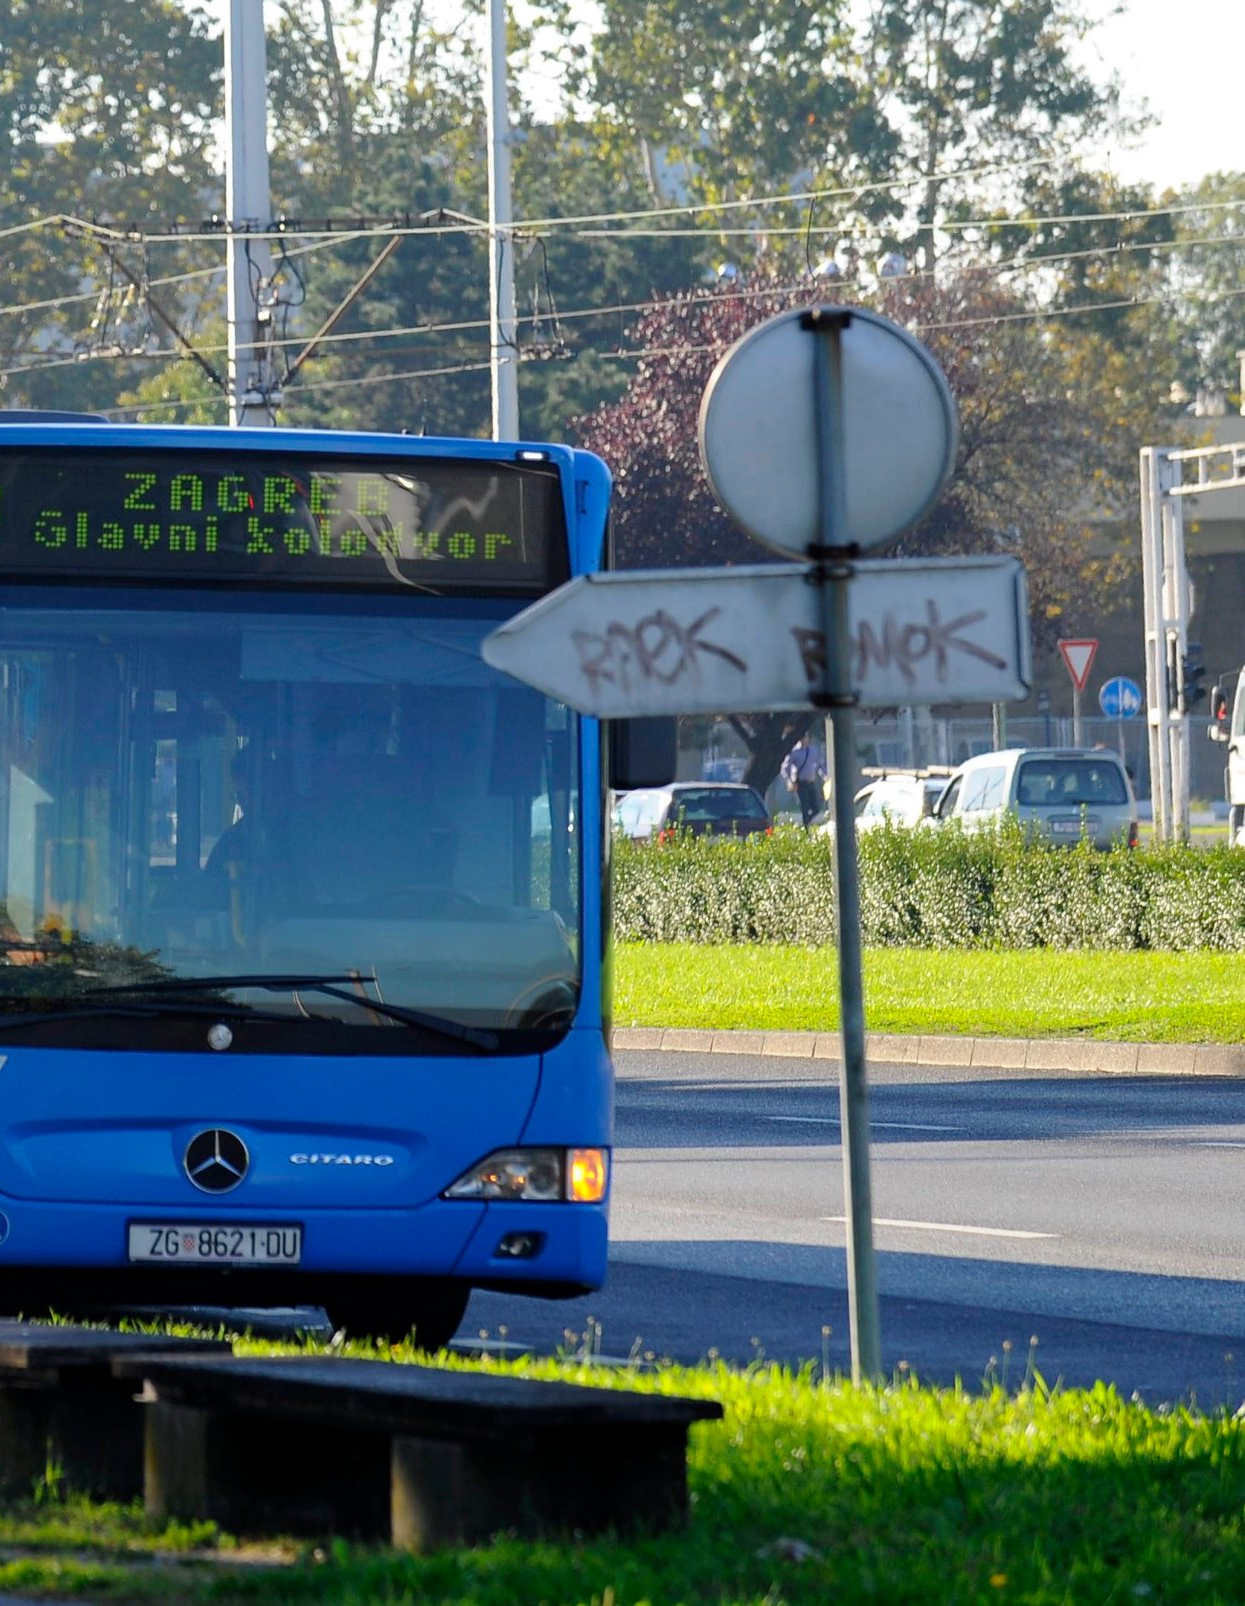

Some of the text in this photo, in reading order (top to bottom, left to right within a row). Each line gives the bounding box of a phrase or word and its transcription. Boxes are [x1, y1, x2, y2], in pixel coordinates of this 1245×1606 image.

[124, 473, 389, 516] ZAGREB
[34, 511, 512, 560] Glavni kolodvor
[289, 1152, 395, 1167] CITARO
[149, 1229, 180, 1257] ZG
